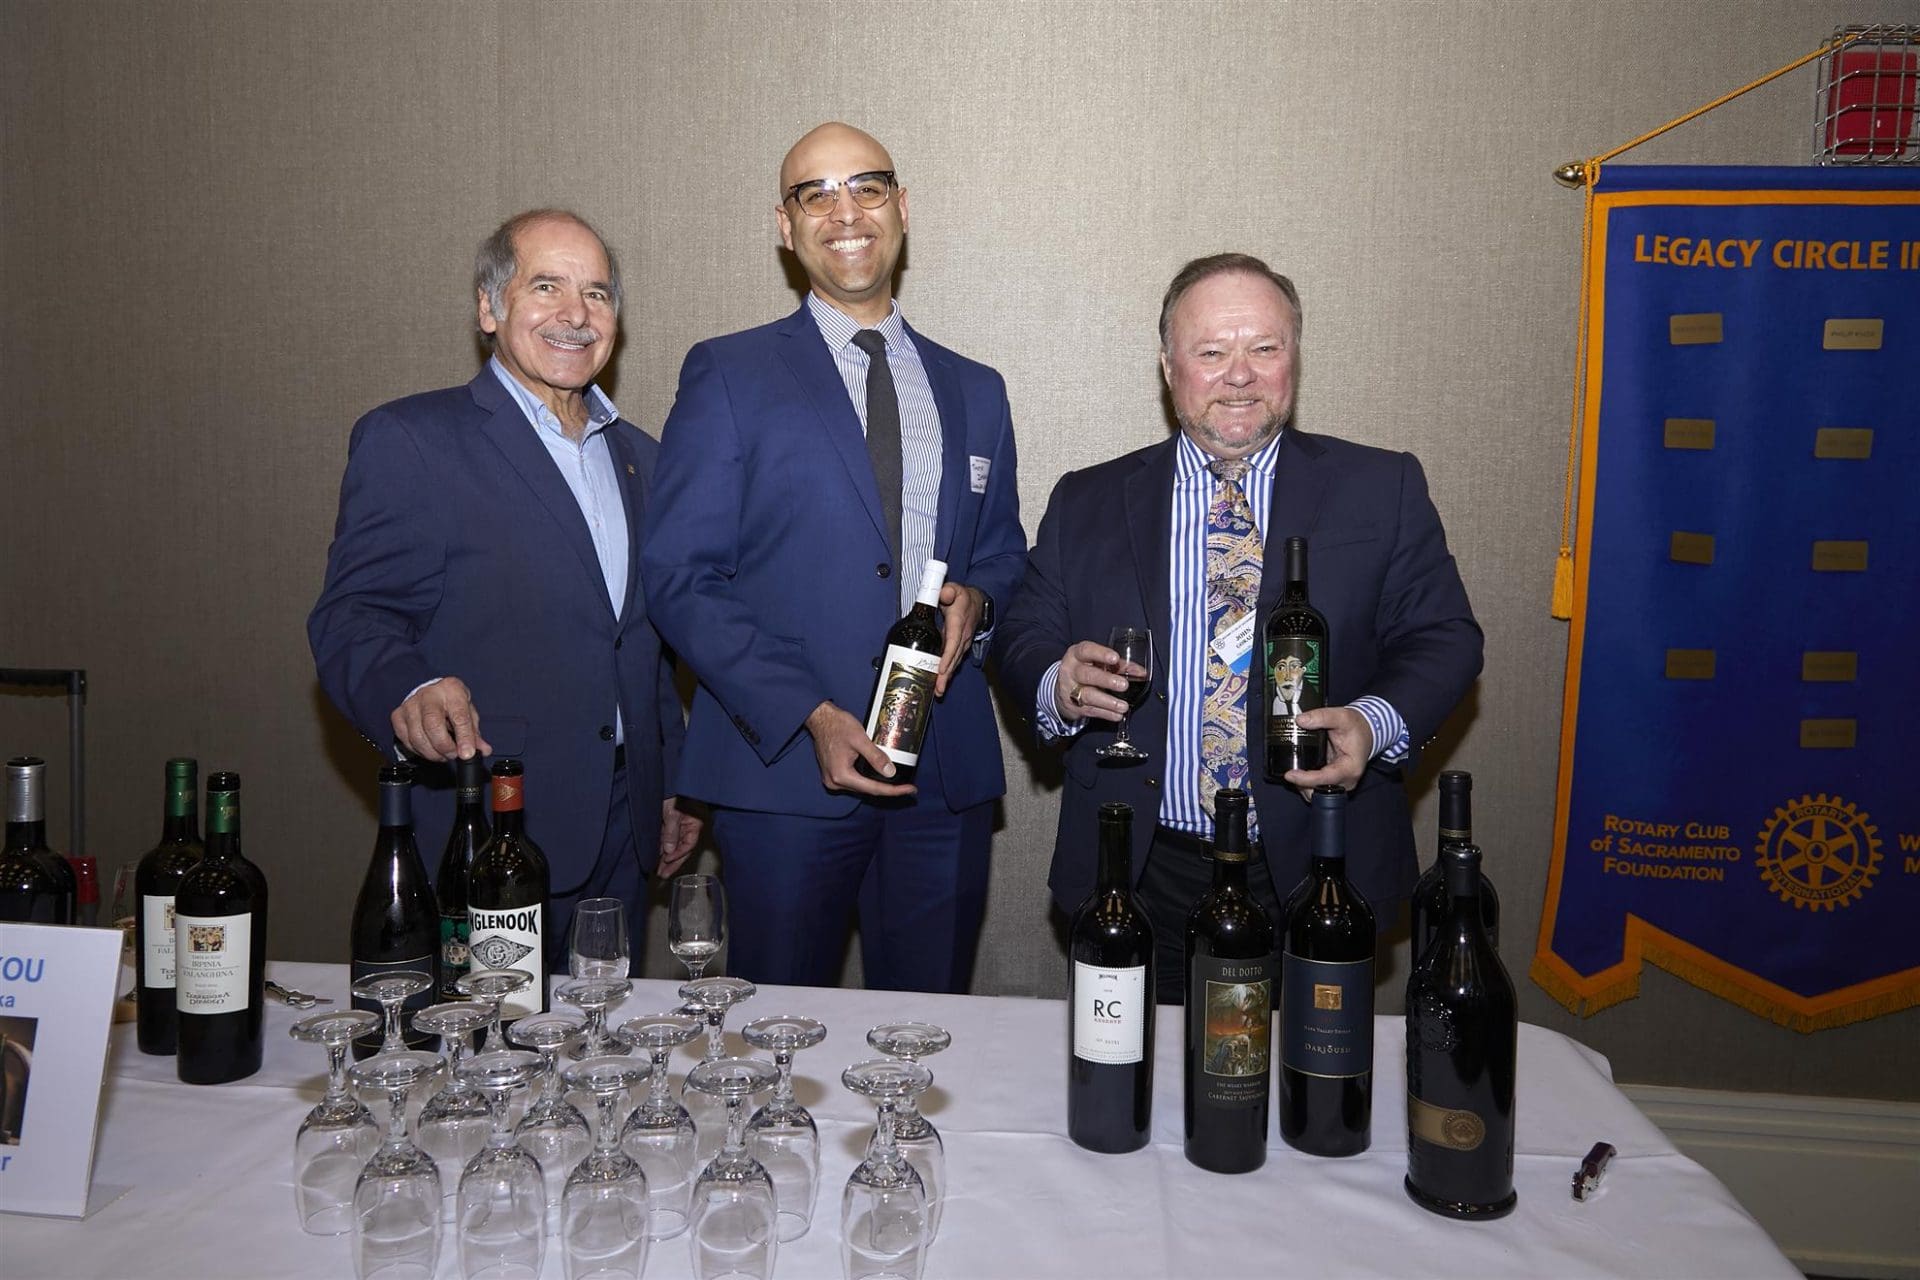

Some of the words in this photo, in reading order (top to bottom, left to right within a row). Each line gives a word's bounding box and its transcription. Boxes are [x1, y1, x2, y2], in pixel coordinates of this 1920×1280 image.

[1634, 234, 1763, 269] LEGACY
[1772, 240, 1889, 270] CIRCLE
[1796, 806, 1847, 820] ROTARY
[1604, 814, 1680, 838] ROTARY
[1685, 821, 1730, 840] CLUB
[1590, 835, 1613, 852] of
[1617, 837, 1741, 861] SACRAMENTO
[1603, 856, 1724, 881] FOUNDATION
[1770, 865, 1862, 900] INTERNATIONAL
[469, 909, 538, 935] NGLENOOK
[0, 956, 44, 983] OU
[1222, 967, 1235, 977] DEL
[1239, 966, 1263, 977] DOTTO
[1094, 999, 1121, 1018] RC
